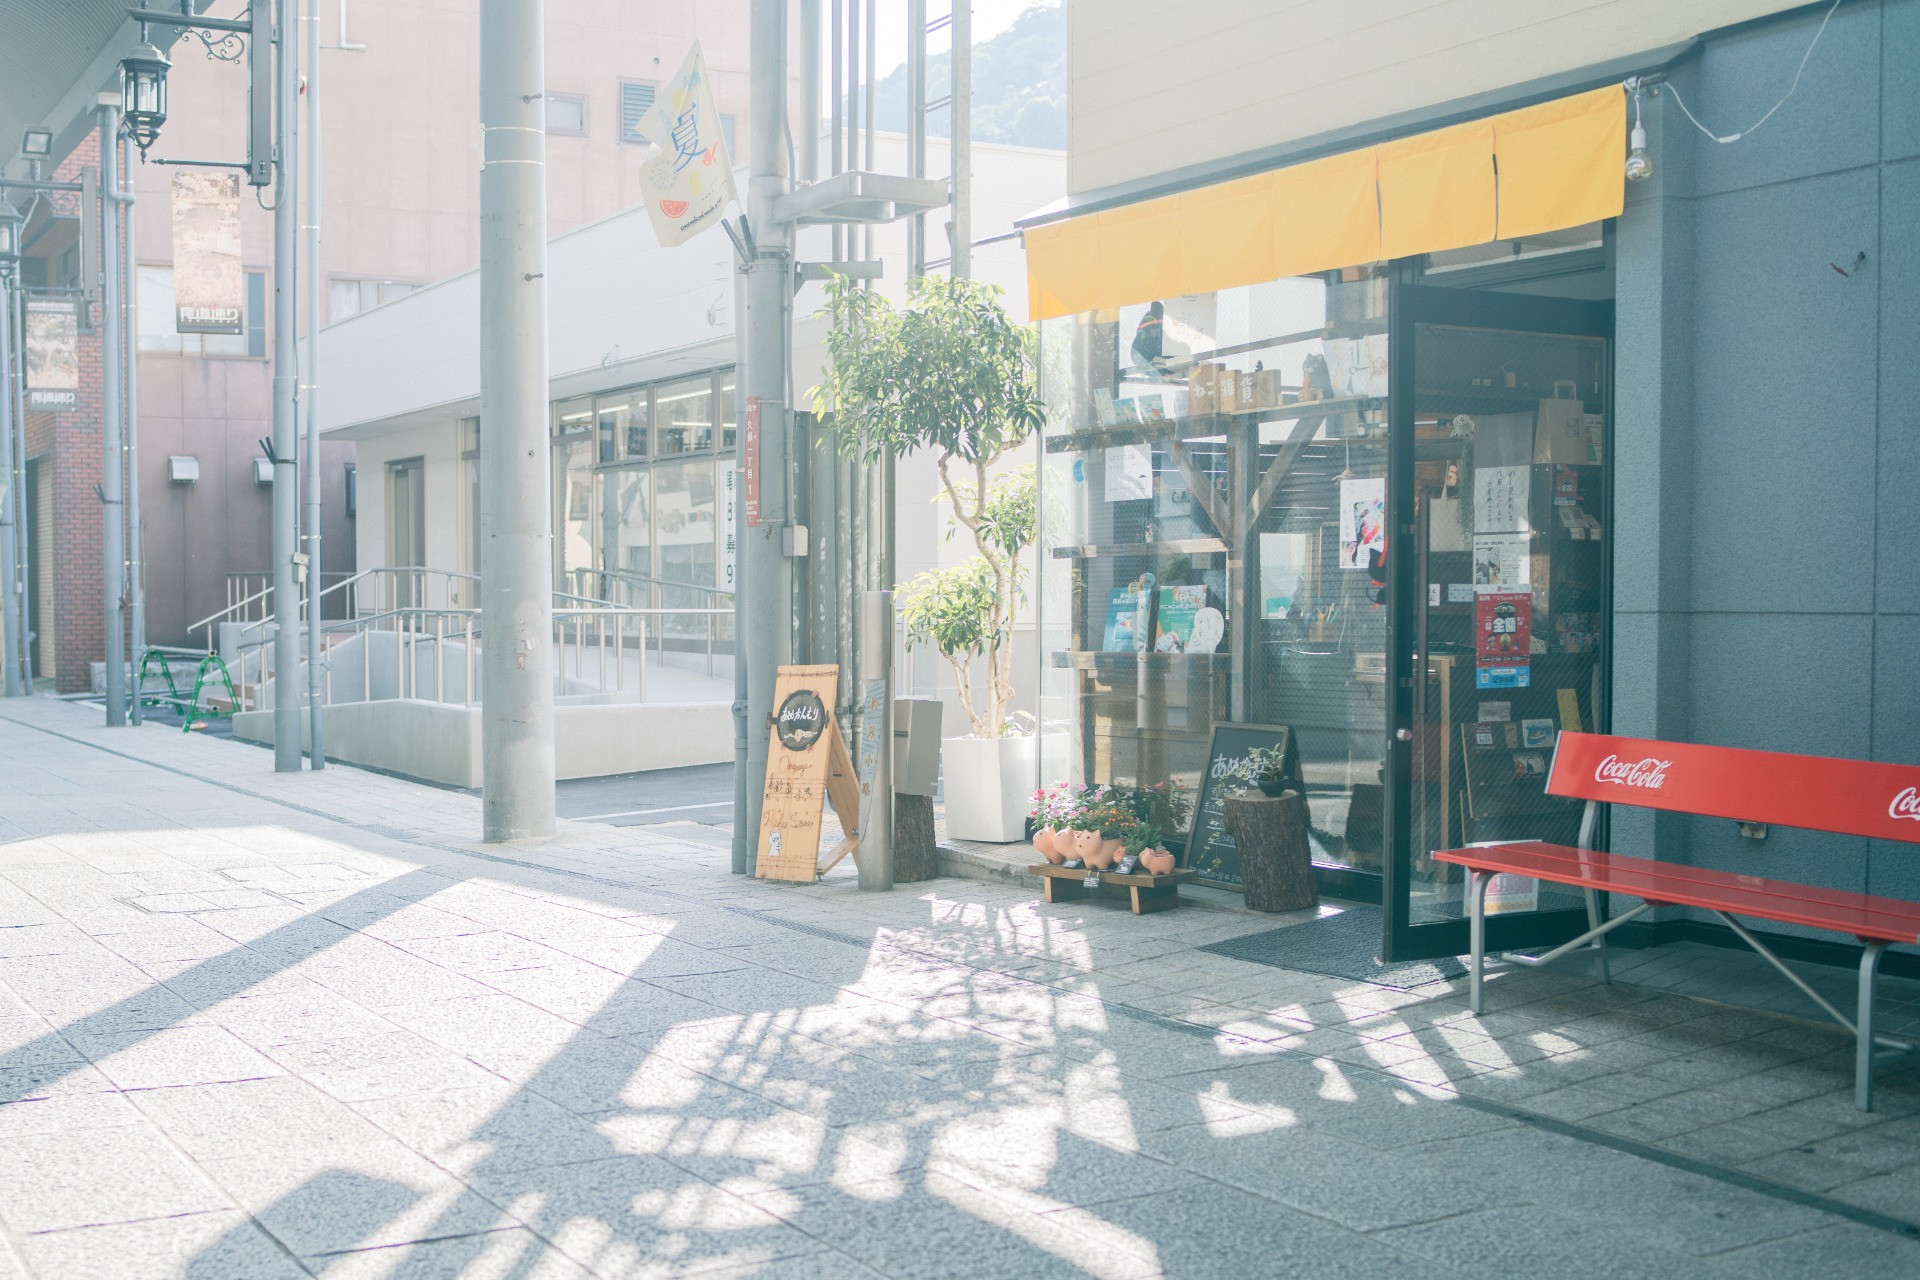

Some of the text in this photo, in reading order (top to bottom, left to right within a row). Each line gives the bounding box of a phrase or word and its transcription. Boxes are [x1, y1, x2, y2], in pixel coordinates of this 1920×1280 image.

[671, 102, 707, 174] 夏
[1493, 617, 1516, 633] 全額
[1594, 754, 1673, 789] Coca-Cola
